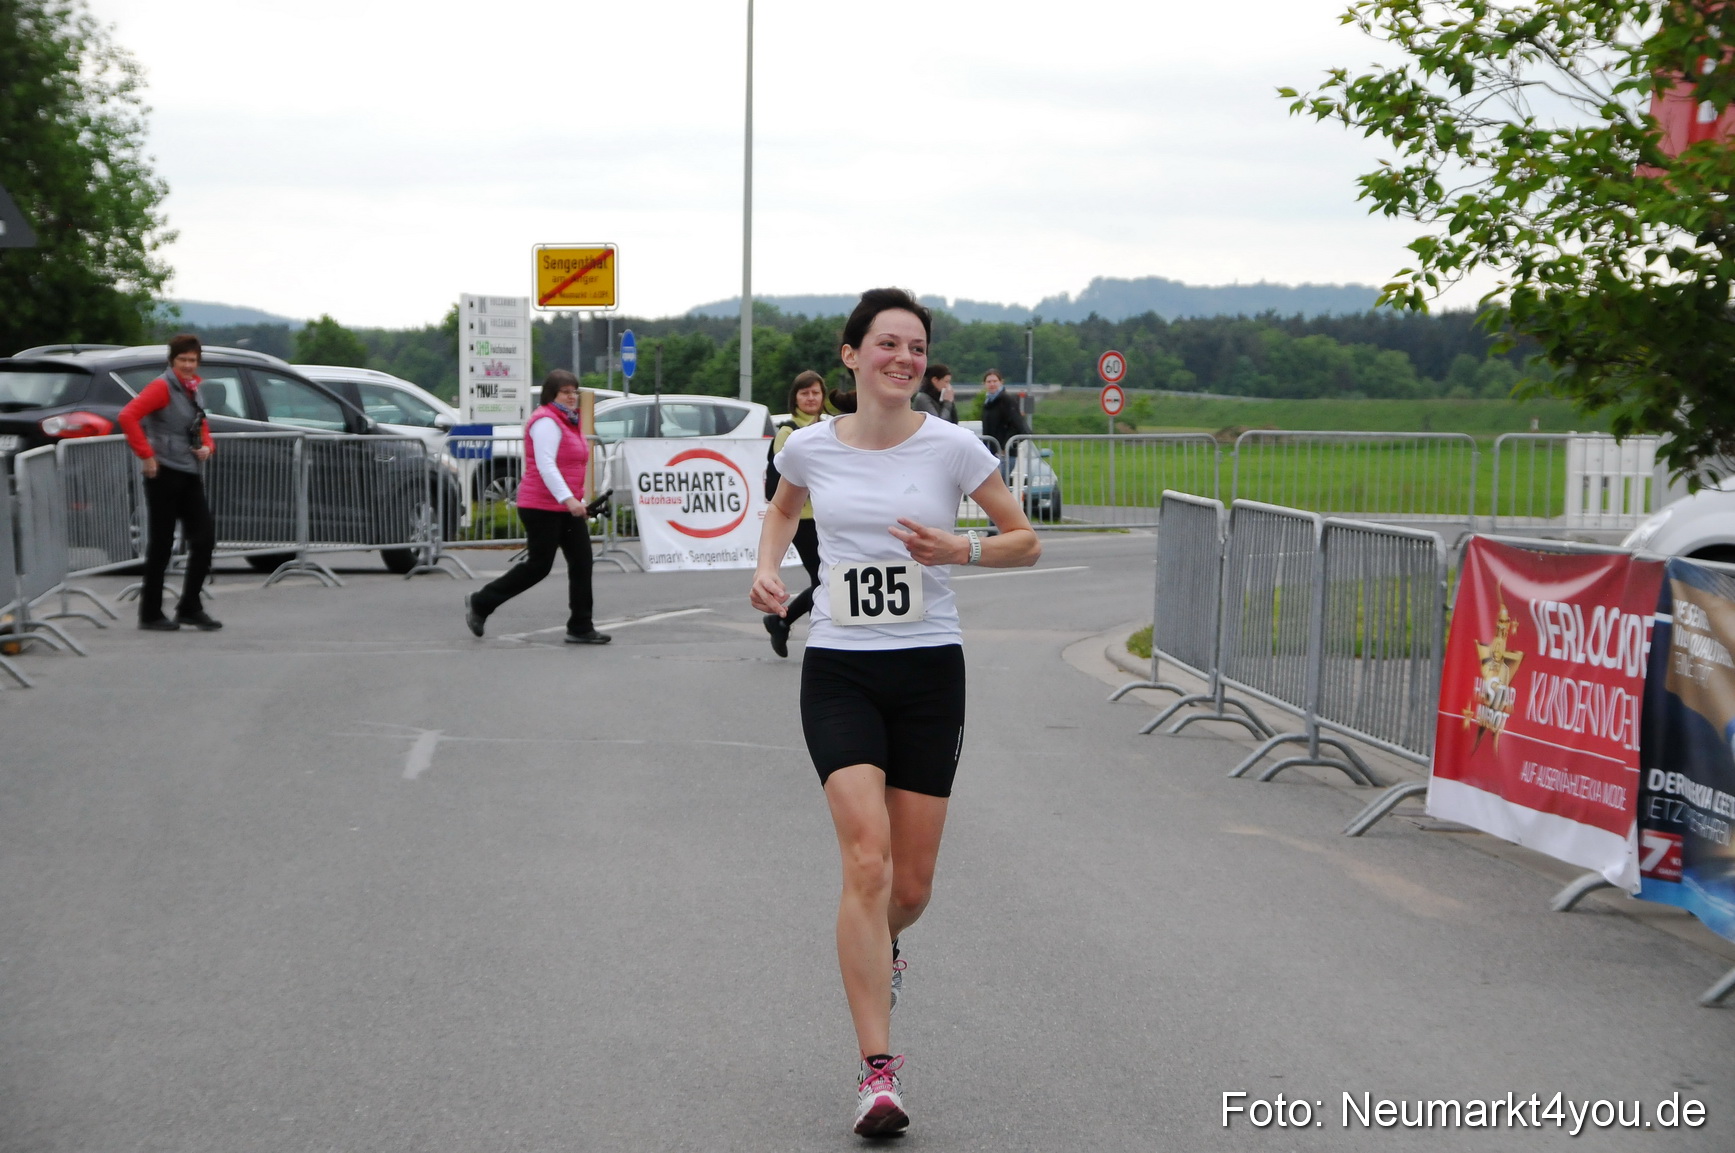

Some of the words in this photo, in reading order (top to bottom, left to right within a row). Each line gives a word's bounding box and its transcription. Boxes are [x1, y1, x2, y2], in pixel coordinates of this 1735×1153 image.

[1106, 361, 1120, 373] 60
[638, 472, 725, 492] GERHART
[728, 476, 736, 486] &
[639, 495, 682, 505] Autohaus
[688, 549, 739, 565] Sengenthal
[843, 566, 910, 617] 135
[1641, 834, 1673, 872] 7
